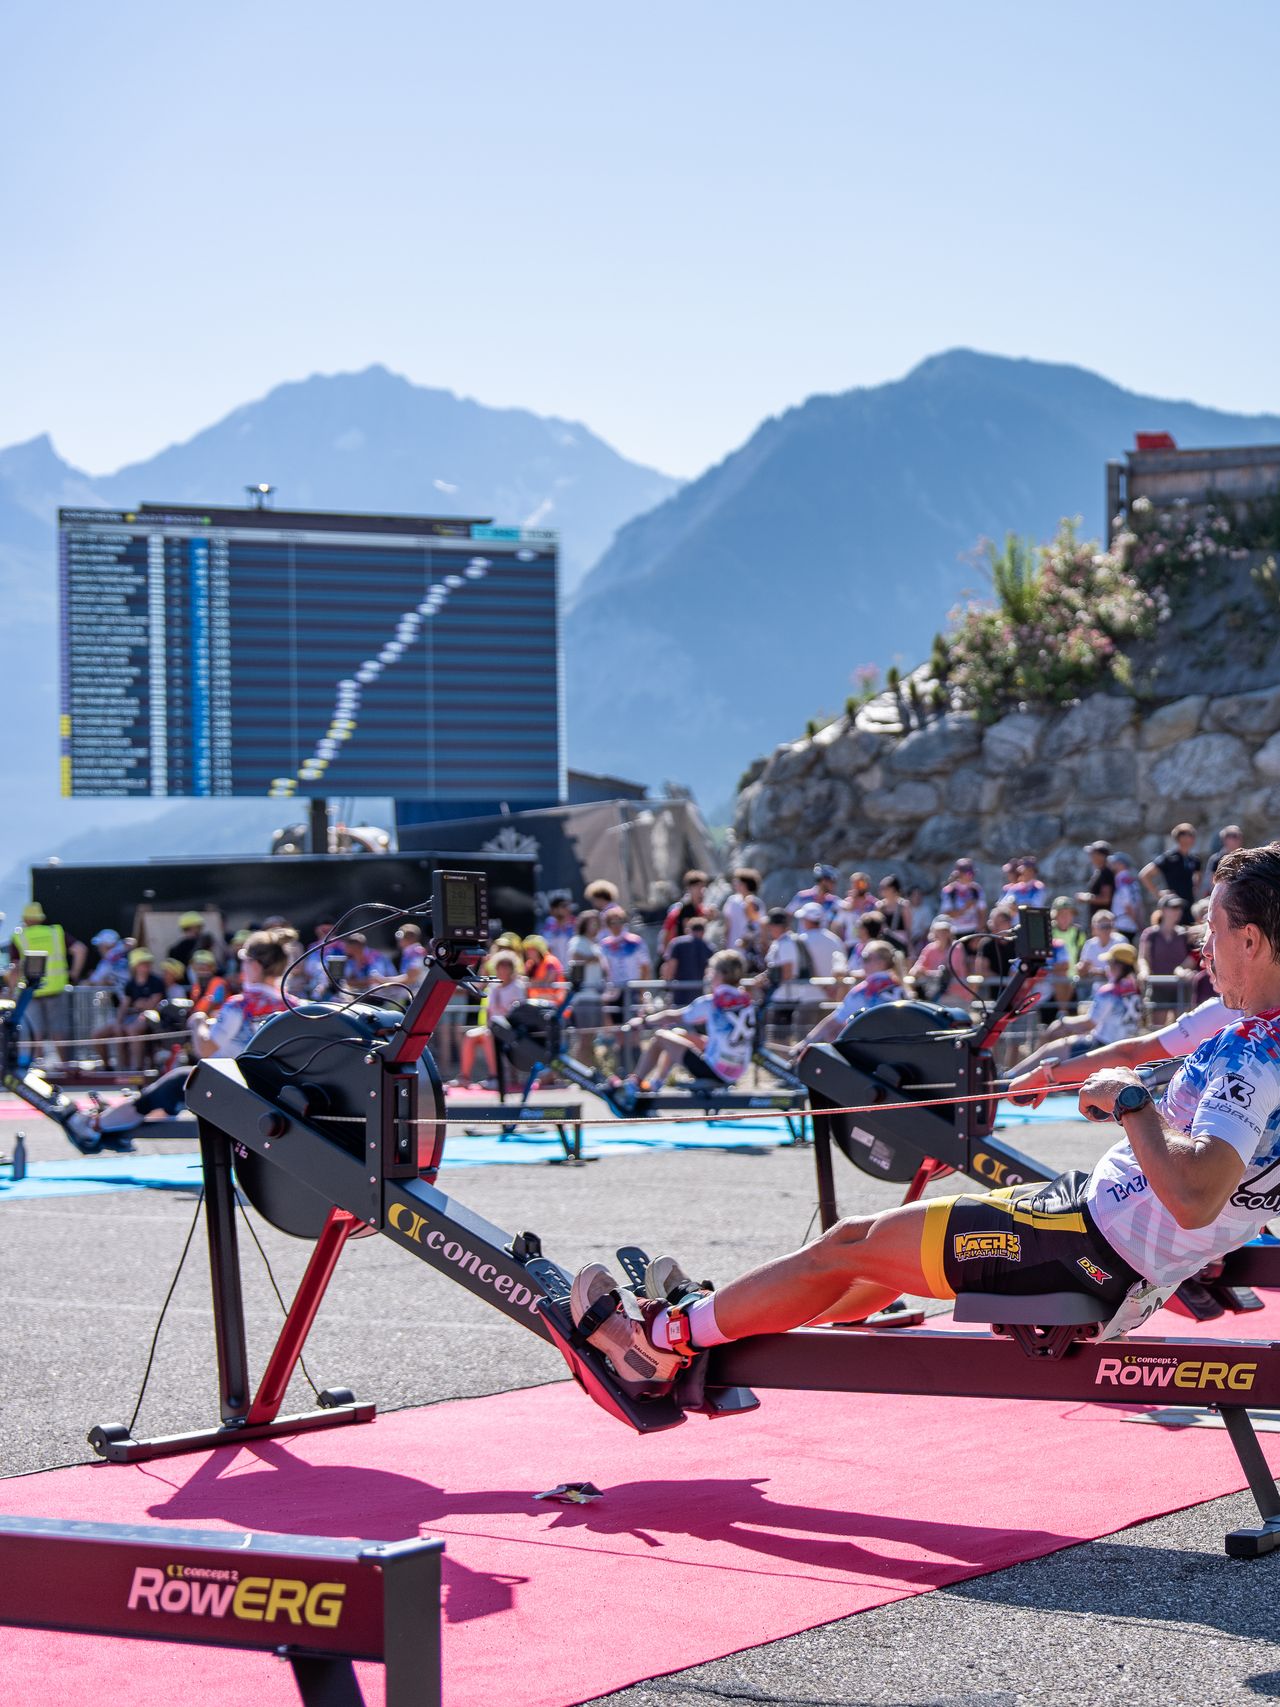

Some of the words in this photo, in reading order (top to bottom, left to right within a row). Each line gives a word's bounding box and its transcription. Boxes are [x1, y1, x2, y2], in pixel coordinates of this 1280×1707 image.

[1211, 1075, 1256, 1110] X3
[1079, 1258, 1113, 1285] DSX
[1095, 1358, 1258, 1390] RowERG
[1137, 1356, 1171, 1365] concept
[231, 1570, 239, 1580] 2
[127, 1566, 346, 1628] RowERG
